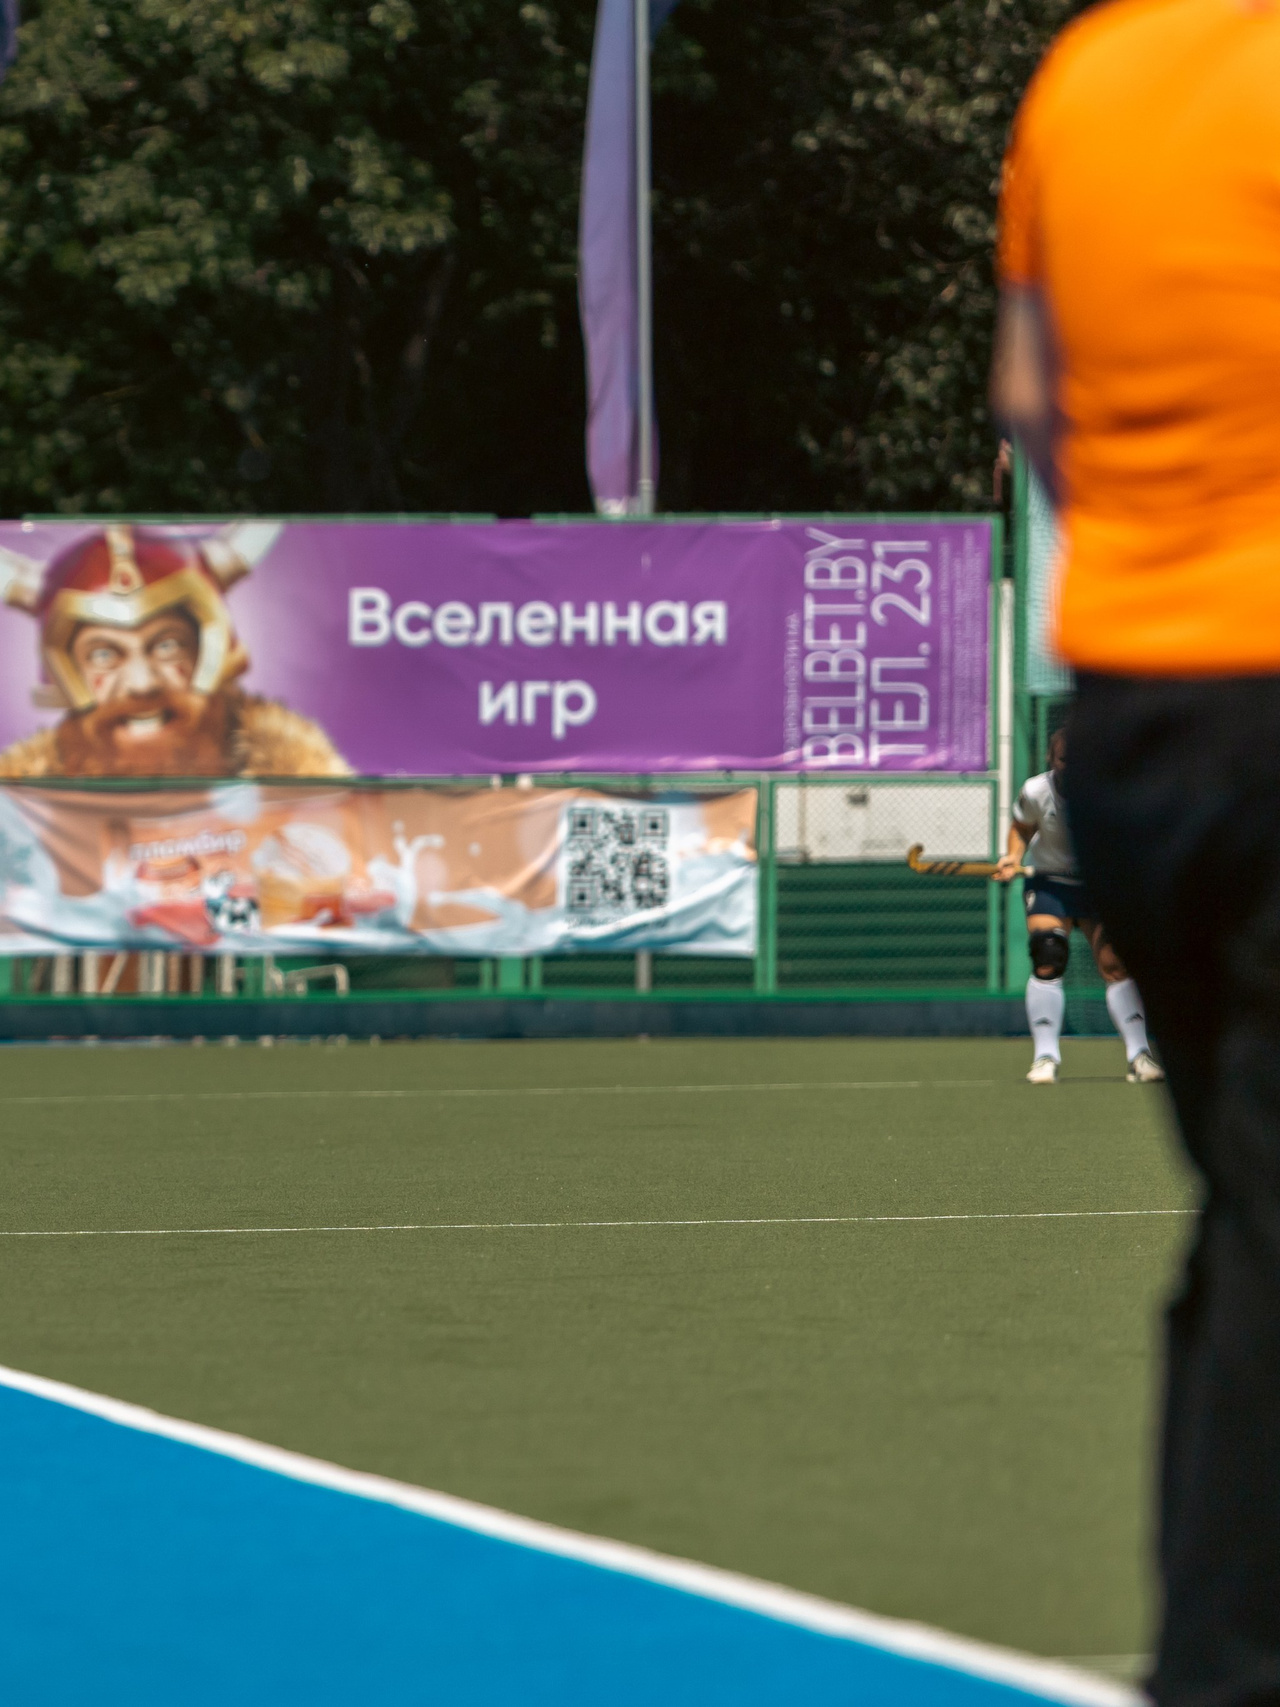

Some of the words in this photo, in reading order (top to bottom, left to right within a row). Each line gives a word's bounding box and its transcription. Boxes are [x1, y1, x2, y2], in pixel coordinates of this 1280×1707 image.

[347, 586, 728, 649] Вселенная
[870, 540, 932, 628] 231
[803, 527, 867, 766] BELBET.BY
[477, 679, 597, 740] игр
[869, 641, 931, 768] ТЕЛ.
